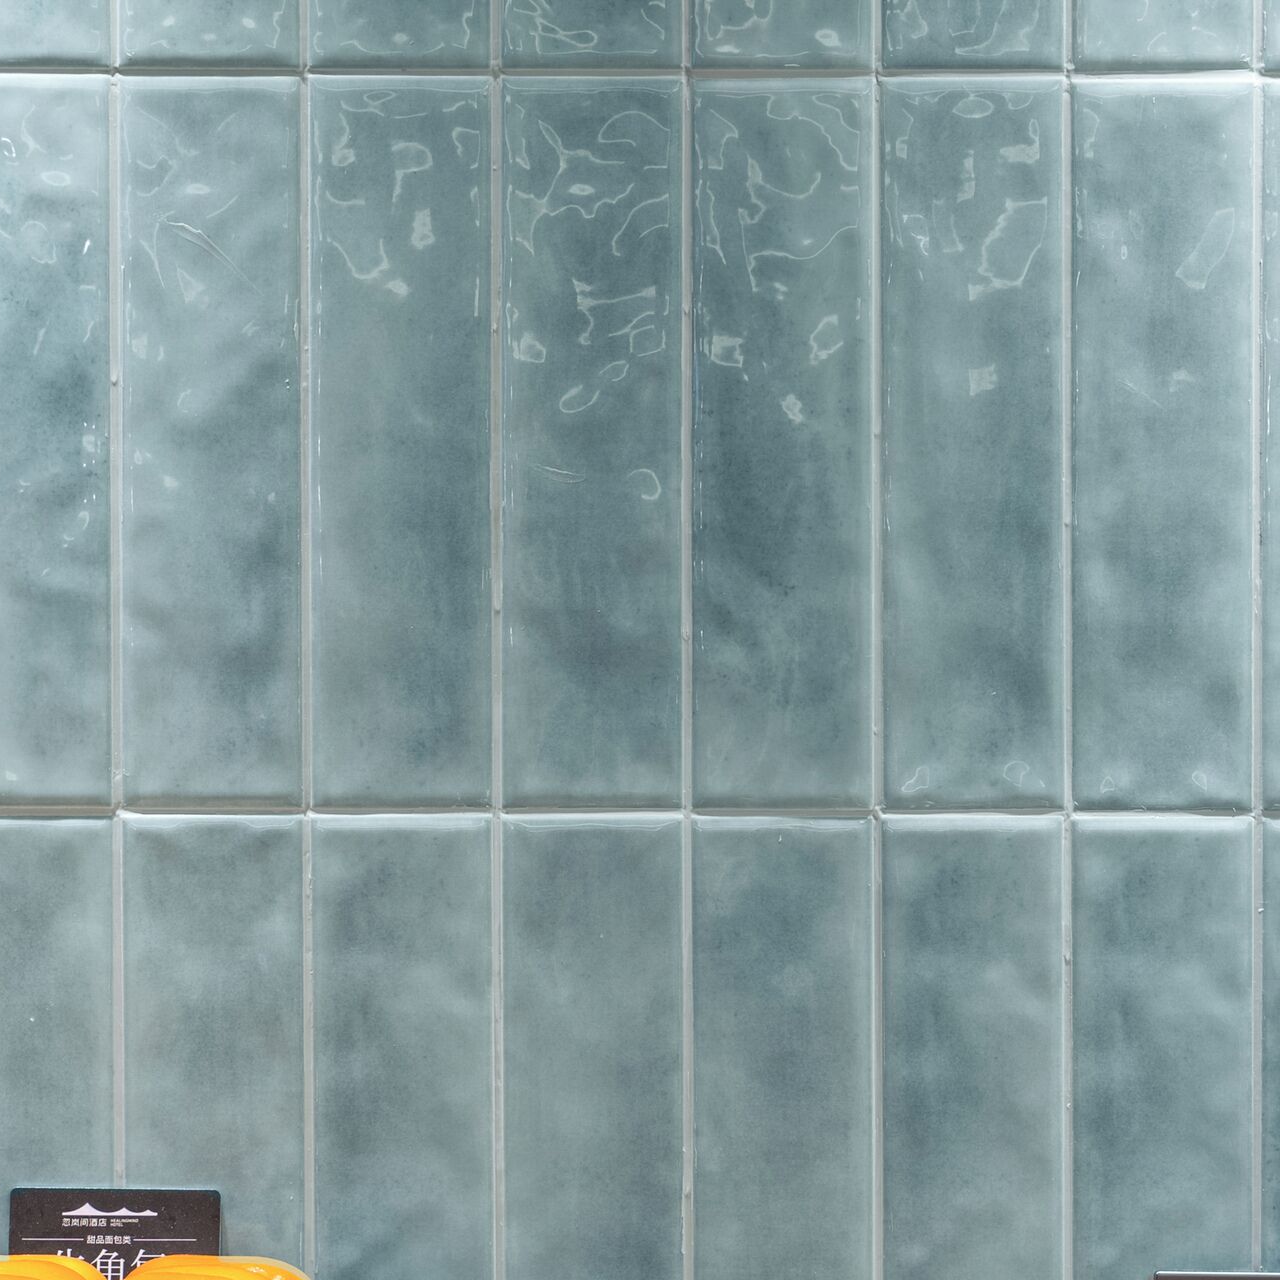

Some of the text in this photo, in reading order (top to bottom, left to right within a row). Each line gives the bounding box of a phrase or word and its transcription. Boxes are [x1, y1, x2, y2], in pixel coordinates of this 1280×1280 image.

[87, 1235, 132, 1245] 甜品面包类
